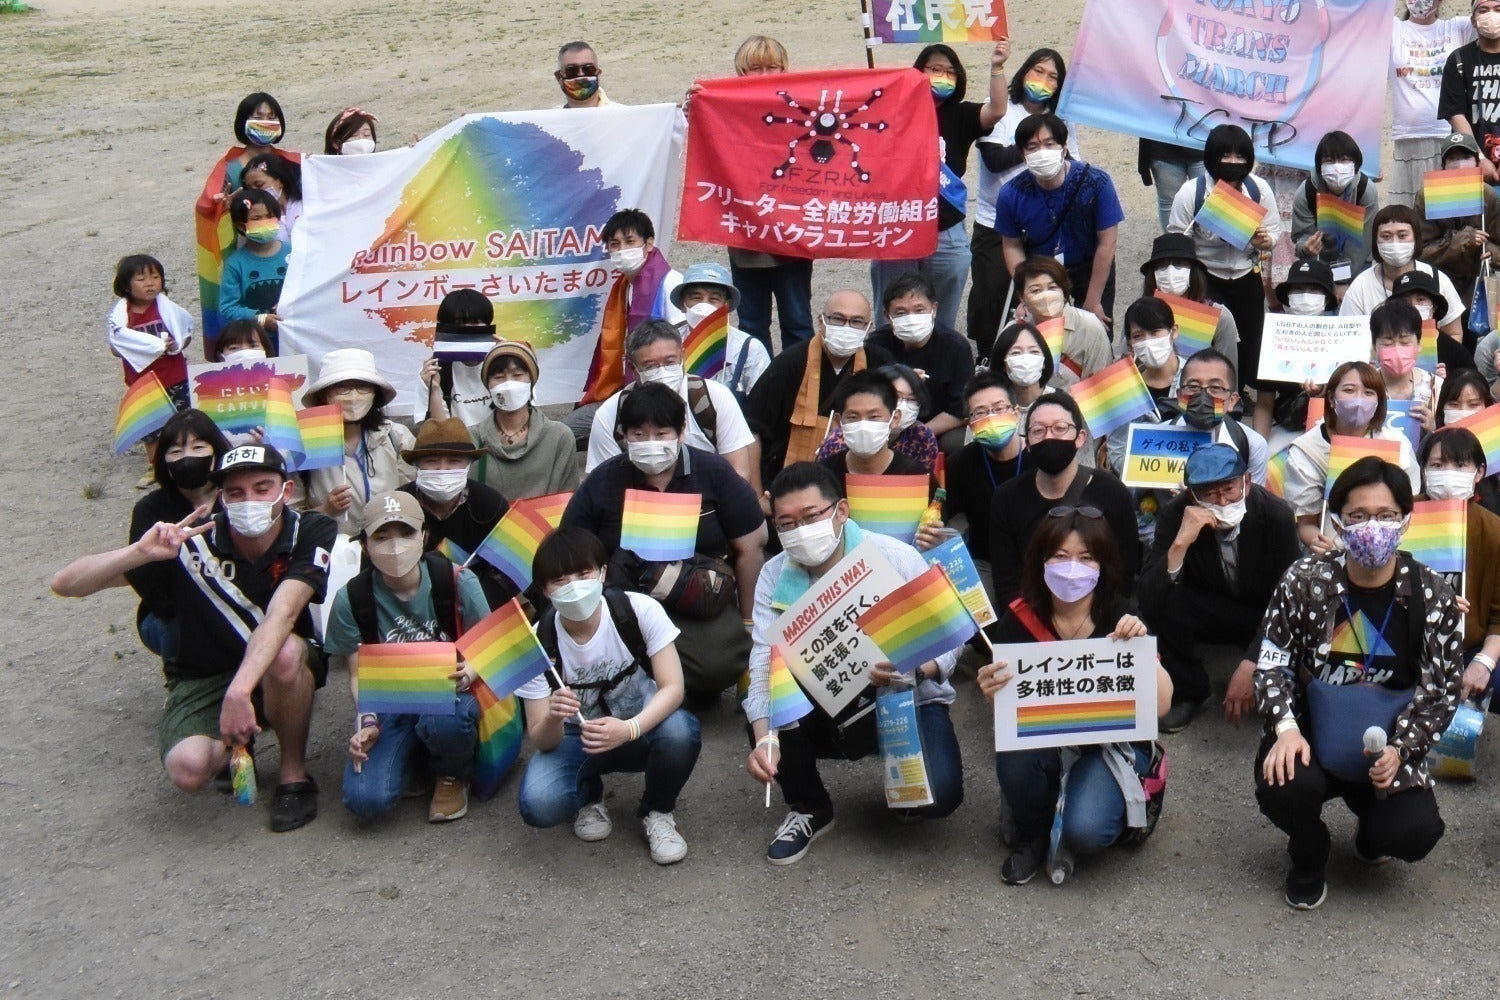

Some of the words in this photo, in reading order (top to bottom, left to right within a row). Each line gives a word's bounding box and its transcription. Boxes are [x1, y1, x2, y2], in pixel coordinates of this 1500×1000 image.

[1187, 13, 1290, 64] TRANS
[1177, 53, 1290, 104] MARCH
[696, 181, 939, 225] フリーター全般労働組合
[720, 211, 914, 248] キャバクラユニオン
[226, 448, 258, 463] 하하
[1139, 458, 1160, 472] NO
[384, 496, 401, 512] LA
[782, 601, 819, 642] MARCH
[816, 580, 843, 609] THIS
[800, 594, 880, 664] この道を行く。
[811, 627, 866, 682] 胸を張っ
[1017, 652, 1135, 674] レインボーは
[825, 660, 869, 698] 堂々と。
[1016, 675, 1135, 698] 多様性の象徴
